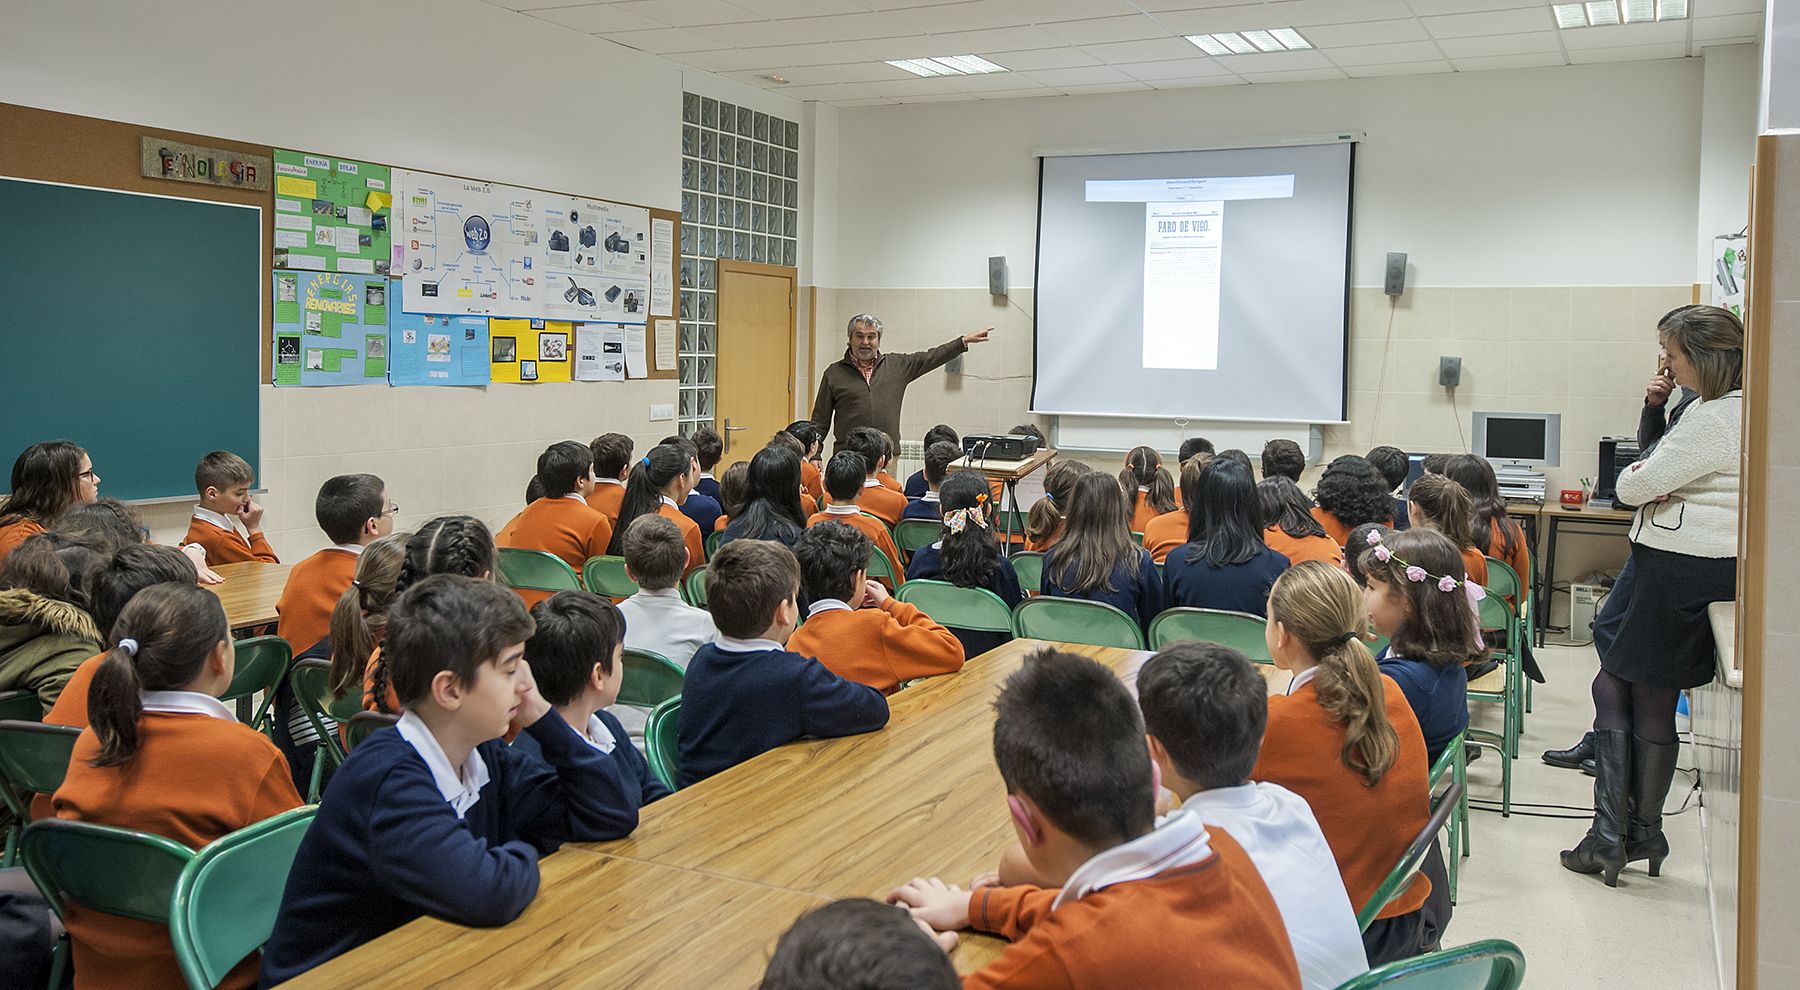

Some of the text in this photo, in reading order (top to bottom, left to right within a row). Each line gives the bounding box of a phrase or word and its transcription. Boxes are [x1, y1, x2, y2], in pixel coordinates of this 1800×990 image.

[339, 164, 356, 172] SOLAR
[470, 185, 481, 193] Web
[1158, 220, 1211, 233] FARO DE VIGO.
[478, 228, 488, 241] 2.0
[305, 297, 356, 315] RENOVABLES
